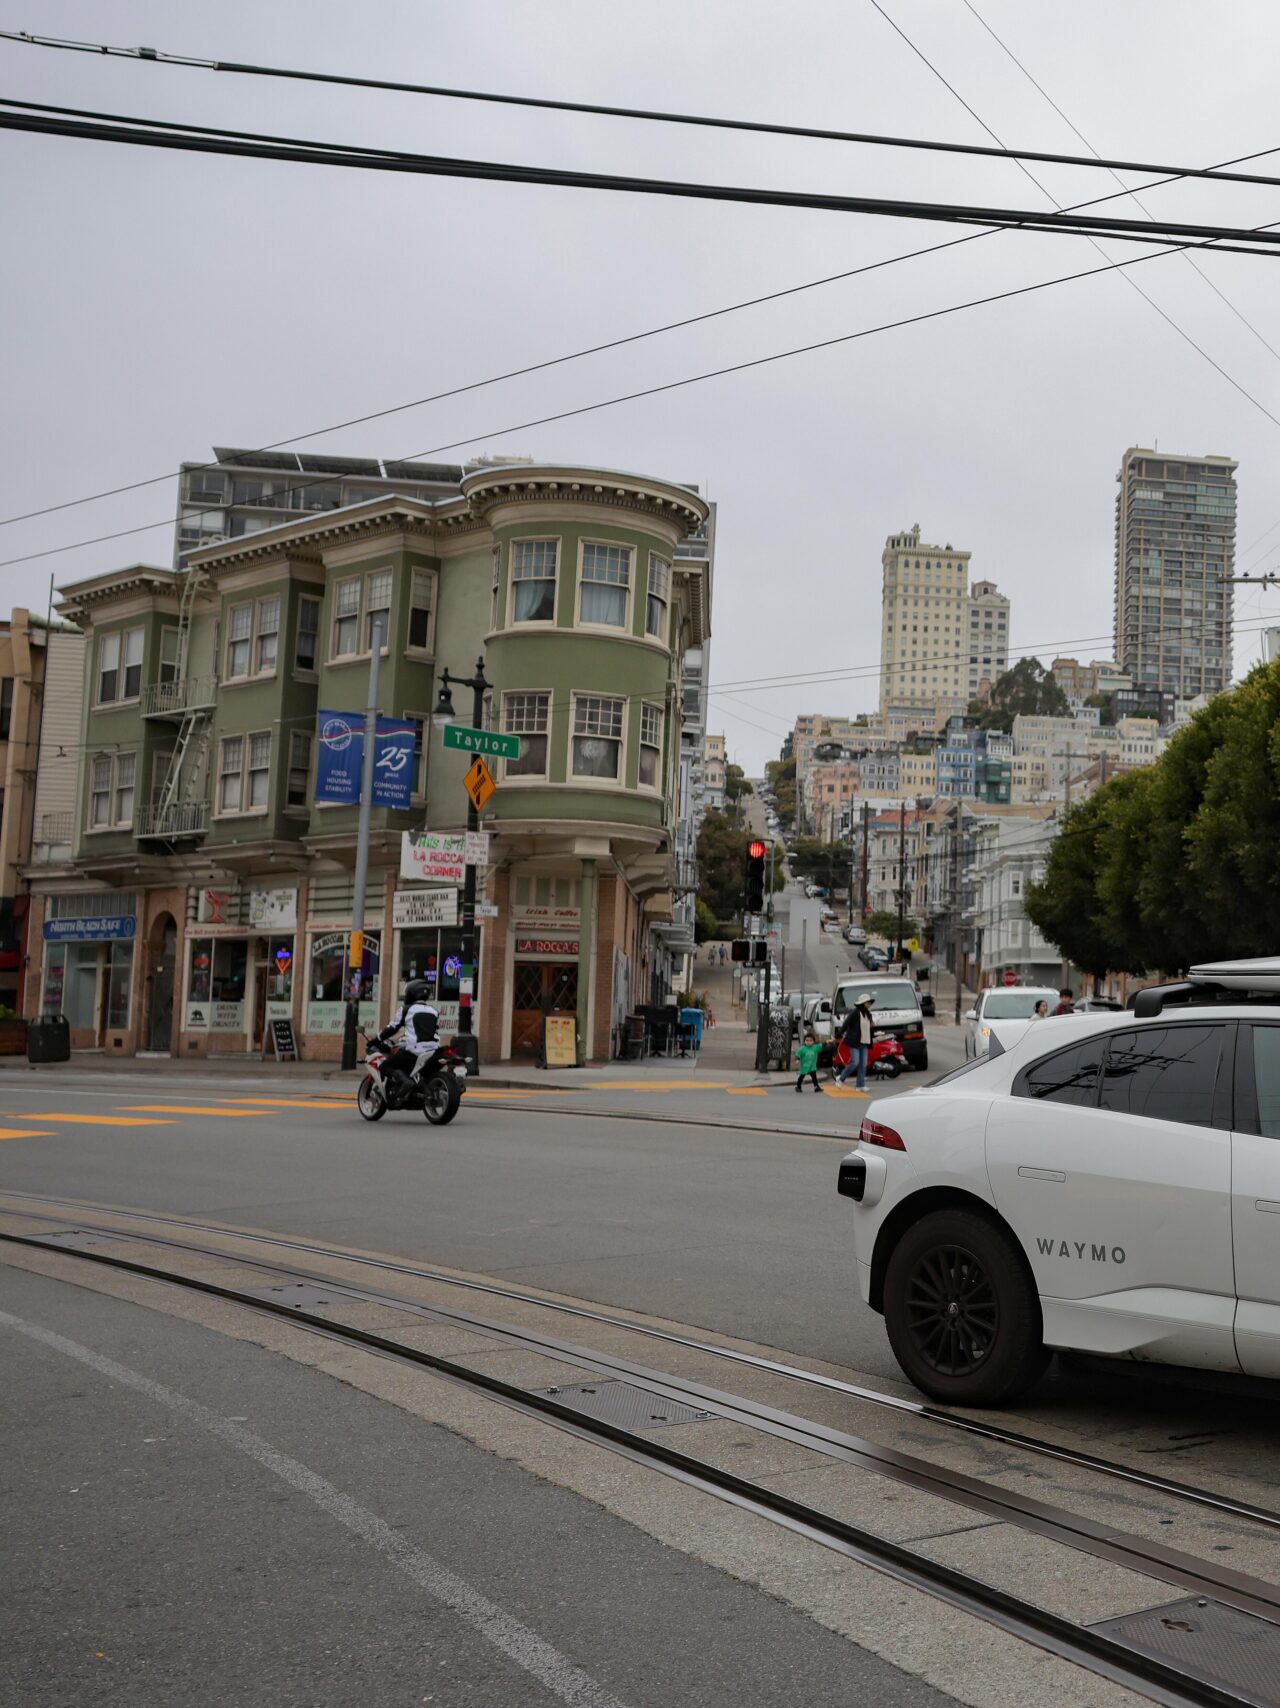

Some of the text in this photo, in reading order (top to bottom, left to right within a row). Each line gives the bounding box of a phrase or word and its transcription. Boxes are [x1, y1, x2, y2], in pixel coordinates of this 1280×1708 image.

[454, 731, 509, 753] Taylor
[375, 746, 412, 771] 25
[330, 768, 348, 778] FOOD
[326, 776, 352, 786] HOUSING
[373, 781, 407, 792] COMMUNITY
[324, 784, 353, 794] STABILITY
[376, 789, 405, 800] IN ACTION
[413, 849, 426, 861] LA
[422, 864, 463, 878] CORNER
[526, 908, 579, 917] Irish Coffee
[50, 918, 121, 933] NORTH BEACH SAFE
[519, 940, 579, 953] LA ROCCA'S
[1036, 1237, 1126, 1264] WAYMO
